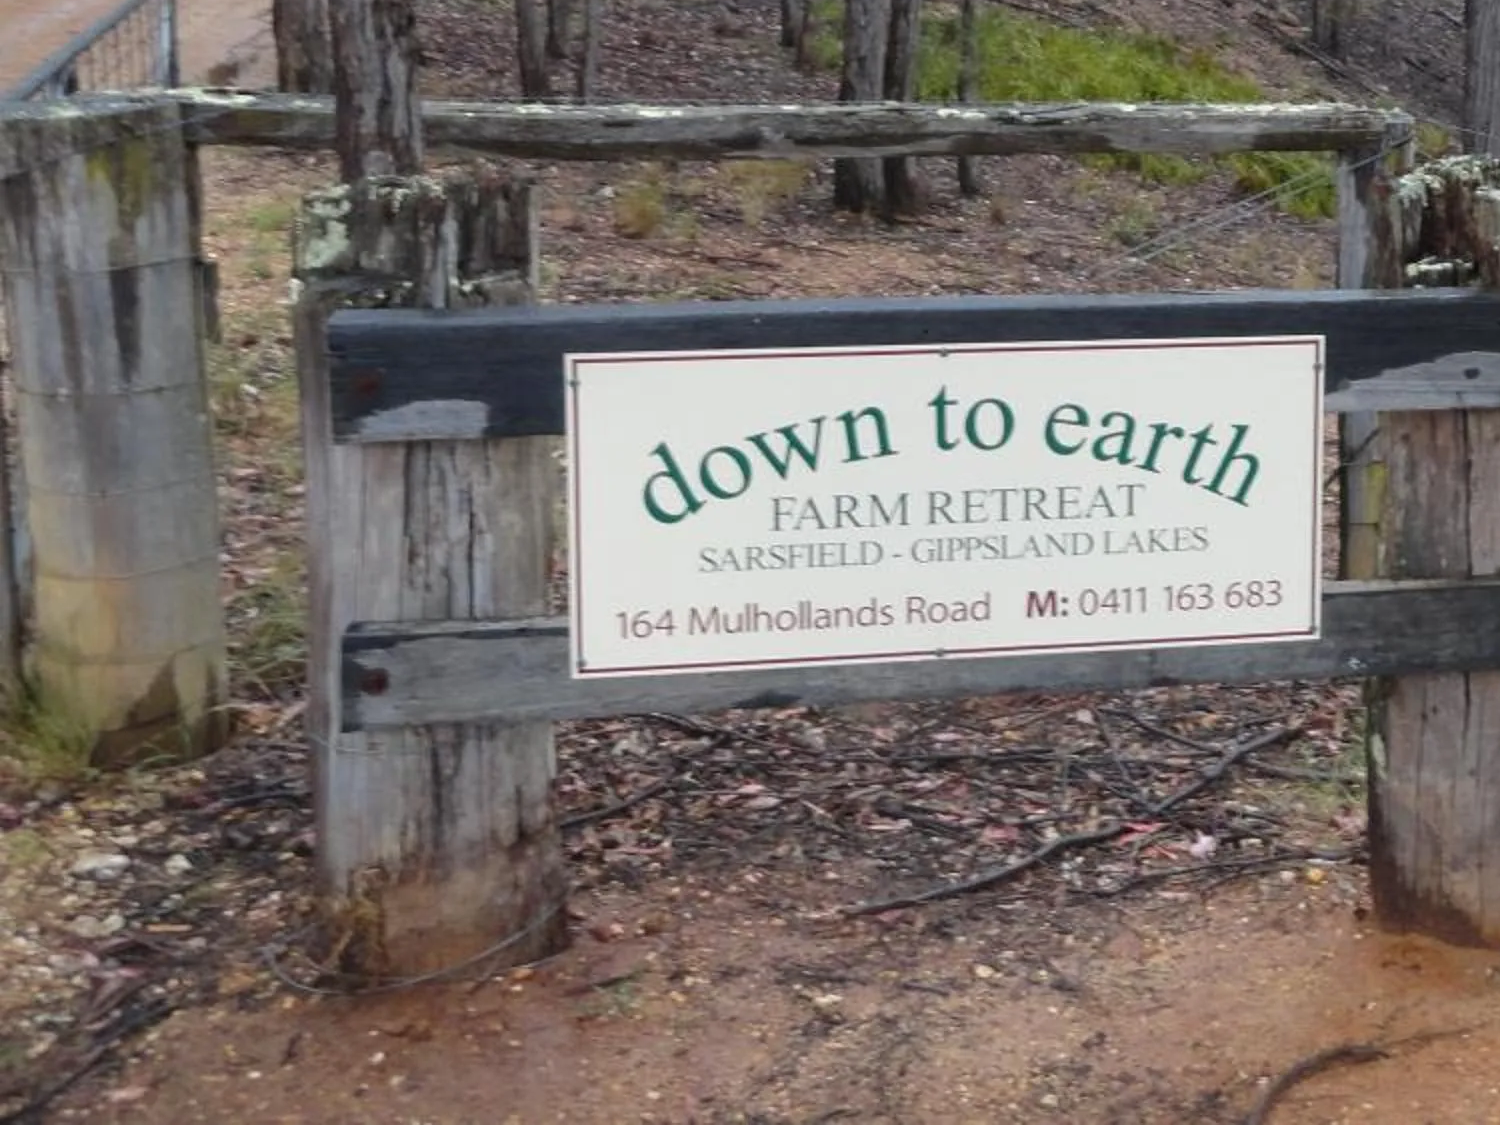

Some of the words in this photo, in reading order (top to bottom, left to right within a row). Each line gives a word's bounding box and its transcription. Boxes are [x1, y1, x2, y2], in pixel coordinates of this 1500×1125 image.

[641, 405, 899, 526] down
[926, 384, 1016, 453] to
[1042, 401, 1261, 508] earth
[769, 491, 910, 532] FARM
[927, 483, 1146, 526] RETREAT
[697, 540, 884, 573] SARSFIELD
[909, 532, 1096, 565] GIPPSLAND
[1101, 526, 1210, 556] LAKES
[615, 608, 677, 640] 164
[688, 600, 896, 637] Mulhollands
[905, 592, 992, 625] Road
[1025, 588, 1070, 619] M:
[1077, 586, 1148, 617] 0411
[1162, 583, 1215, 612] 163
[1224, 579, 1283, 610] 683
